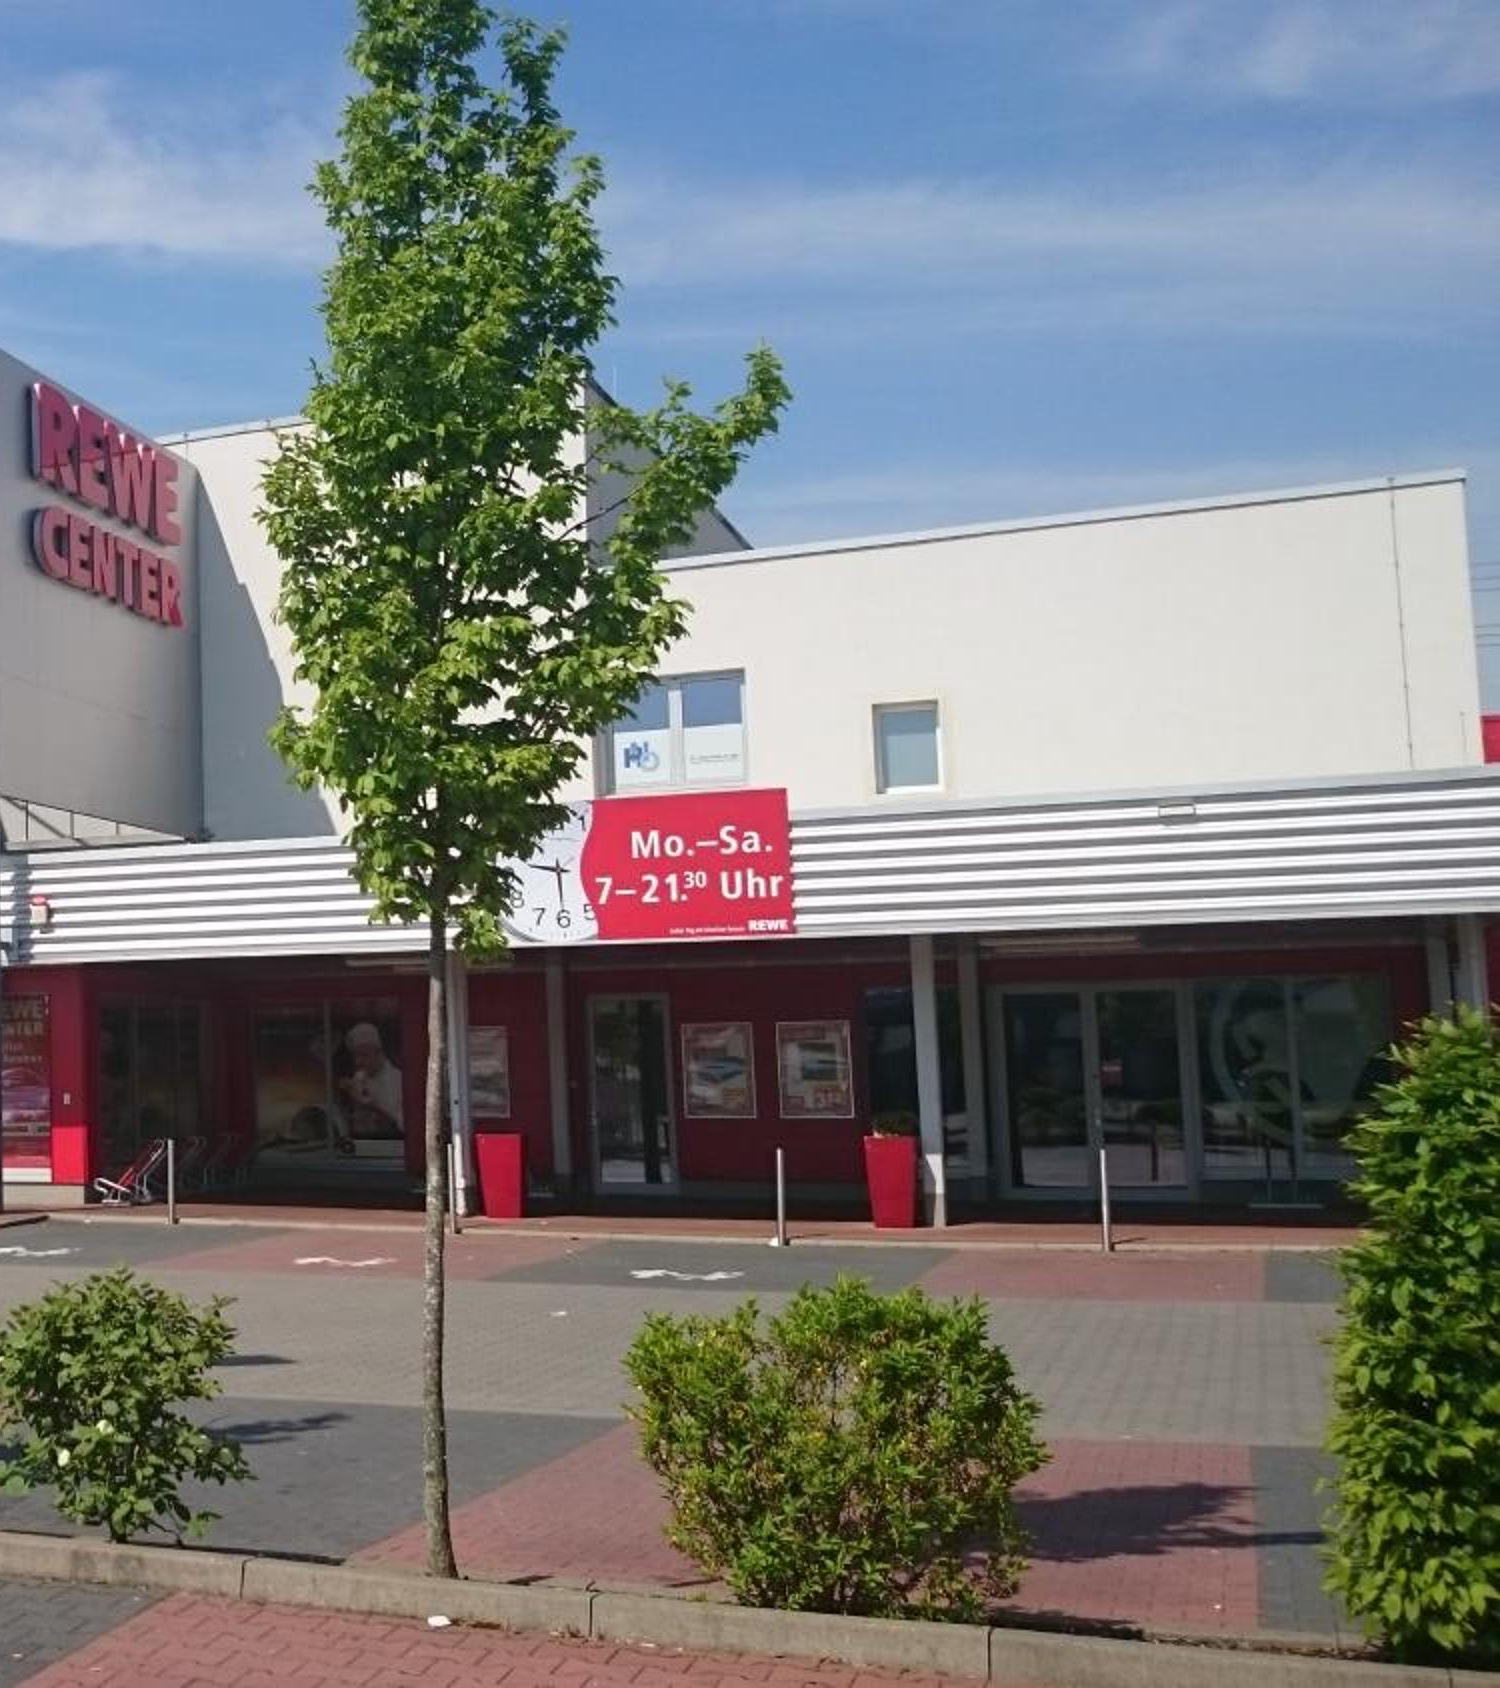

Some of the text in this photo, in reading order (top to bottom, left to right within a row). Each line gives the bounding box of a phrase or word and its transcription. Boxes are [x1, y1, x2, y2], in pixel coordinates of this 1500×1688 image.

[33, 382, 181, 545] REWE
[34, 507, 182, 627] CENTER
[631, 825, 772, 859] Mo.–Sa.
[720, 868, 784, 900] Uhr
[532, 907, 545, 926] 7
[556, 908, 571, 929] 6
[748, 919, 789, 931] REWE
